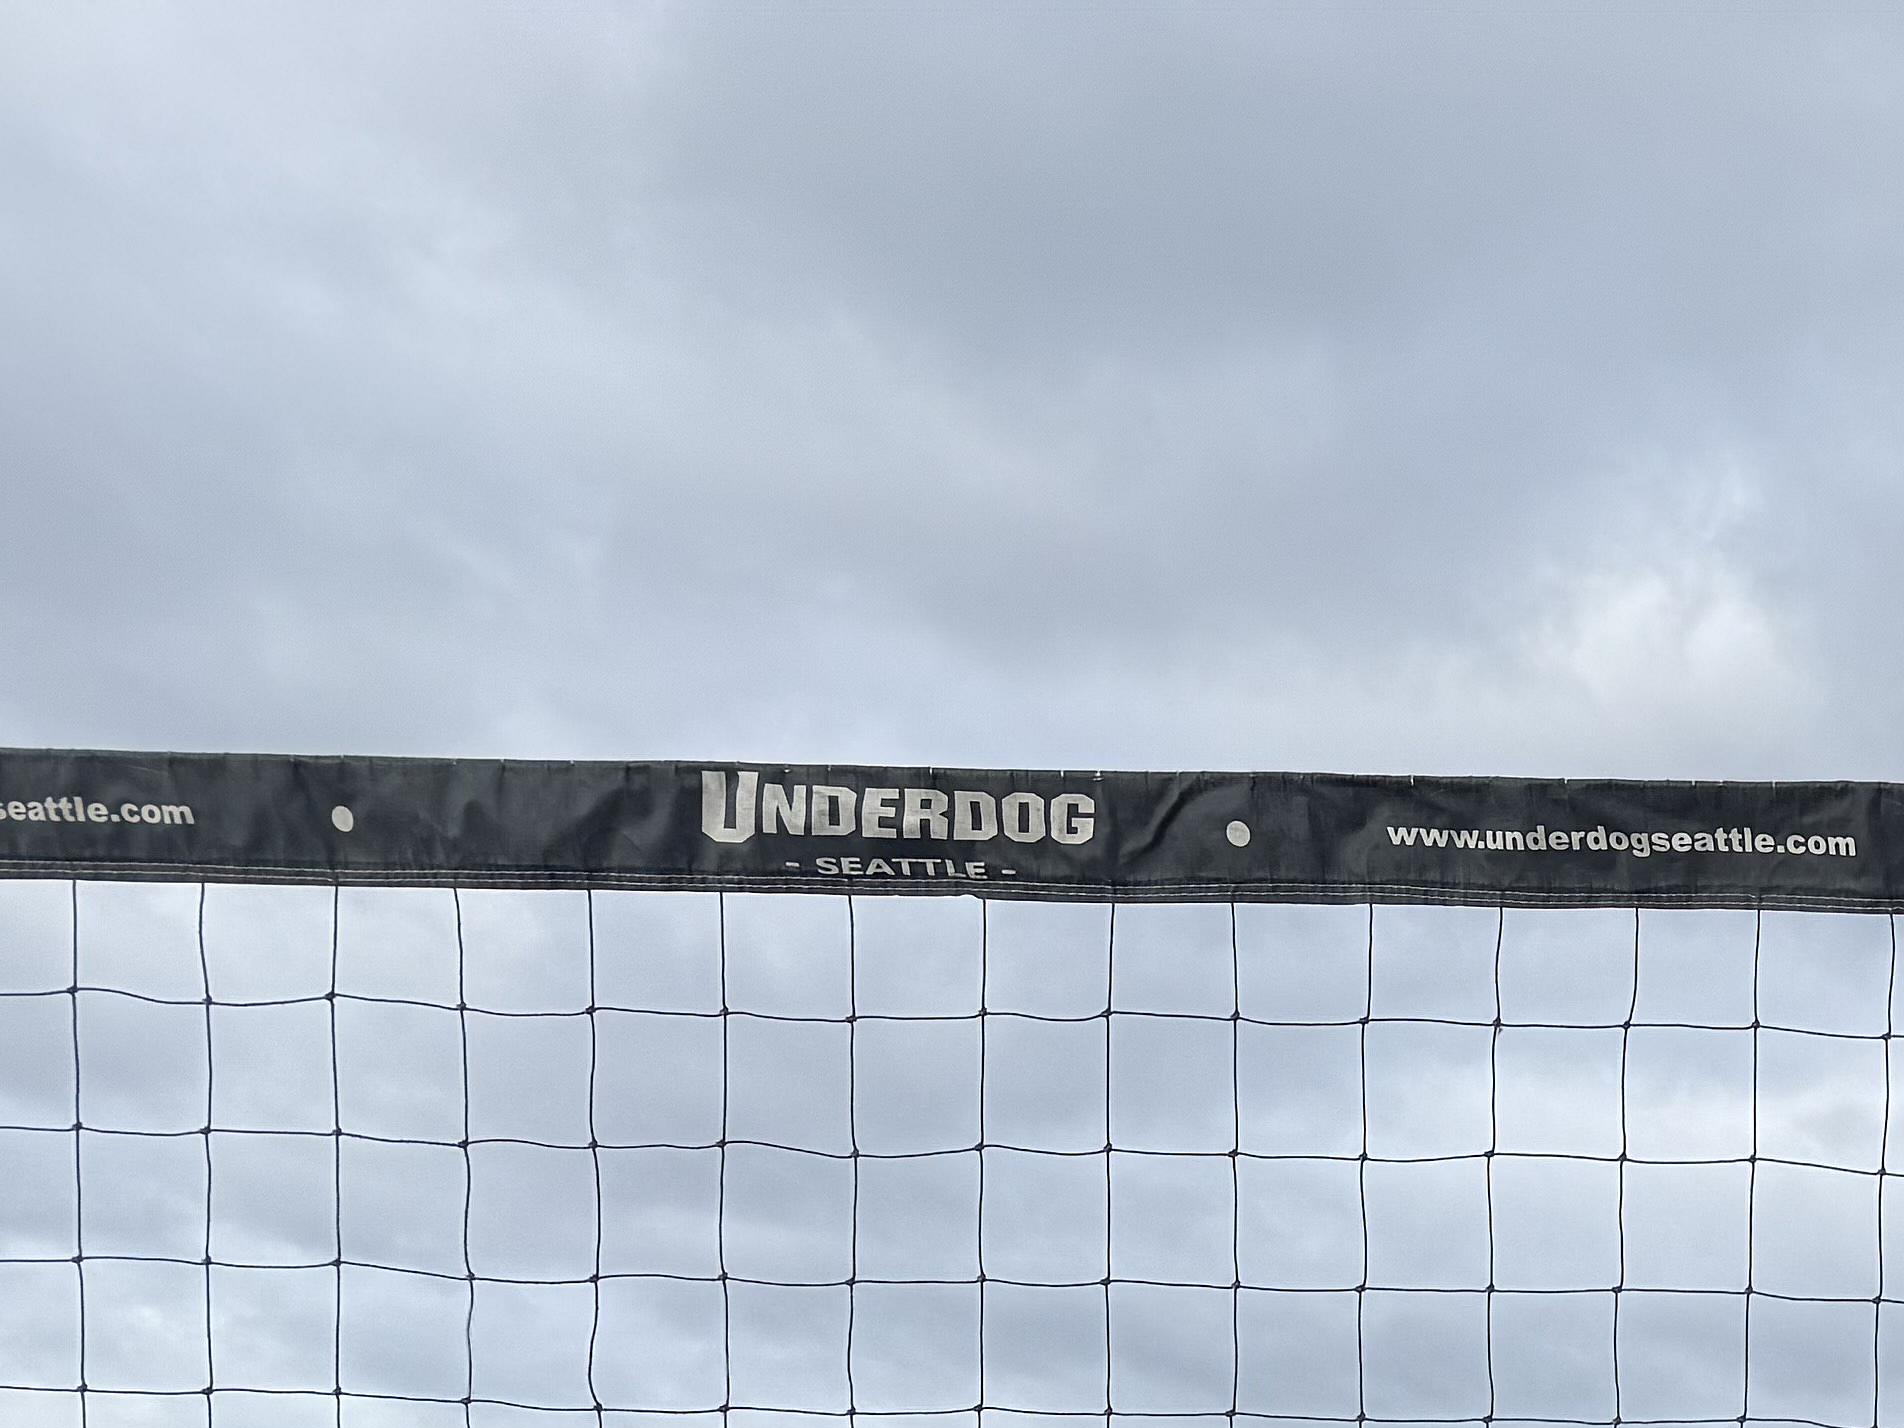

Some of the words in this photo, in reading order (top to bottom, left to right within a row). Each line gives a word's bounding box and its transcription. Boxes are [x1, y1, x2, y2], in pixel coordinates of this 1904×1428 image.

[701, 770, 1095, 845] UNDERDOG
[1386, 825, 1856, 858] www.underdogseattle.com
[815, 857, 986, 879] SEATTLE
